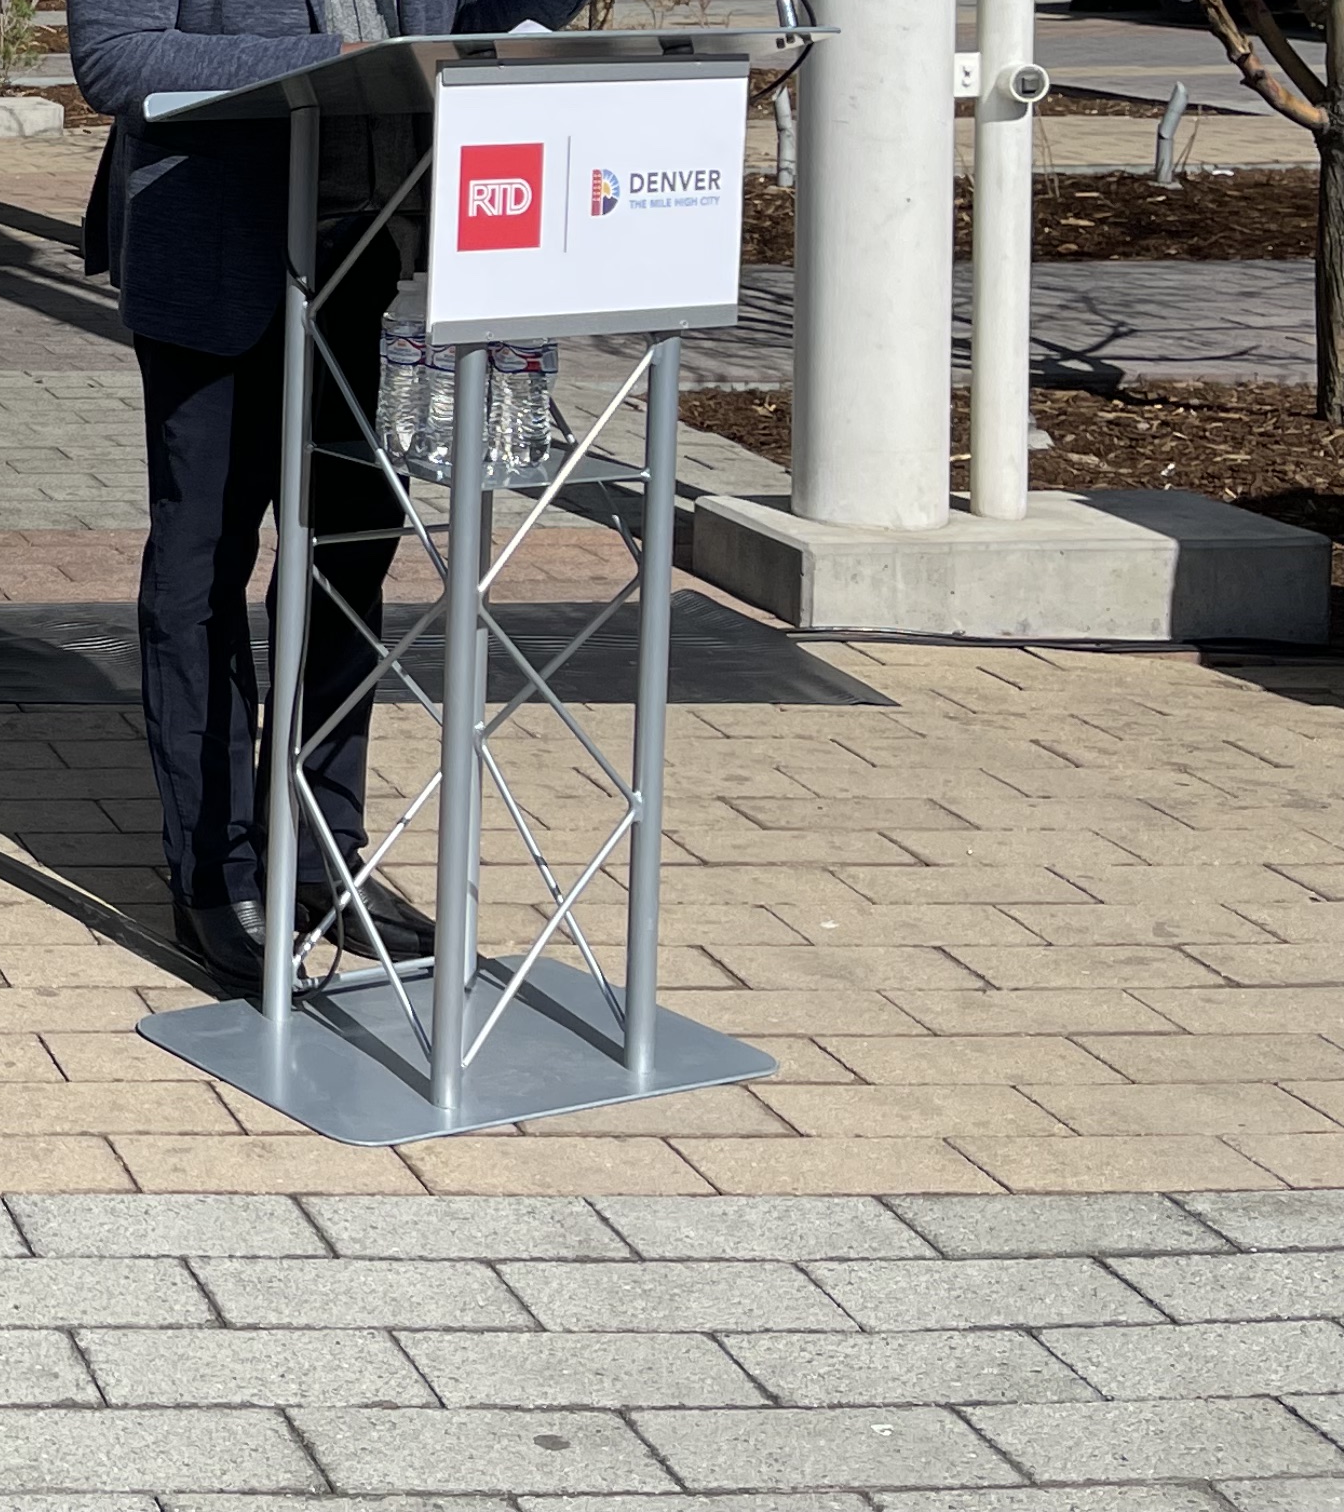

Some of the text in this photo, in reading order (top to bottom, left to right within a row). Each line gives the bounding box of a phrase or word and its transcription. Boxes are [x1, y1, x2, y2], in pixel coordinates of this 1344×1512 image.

[629, 169, 721, 194] DENVER
[468, 178, 532, 217] RTD
[628, 199, 647, 209] THE
[674, 197, 698, 207] HIGH
[700, 195, 720, 206] CITY
